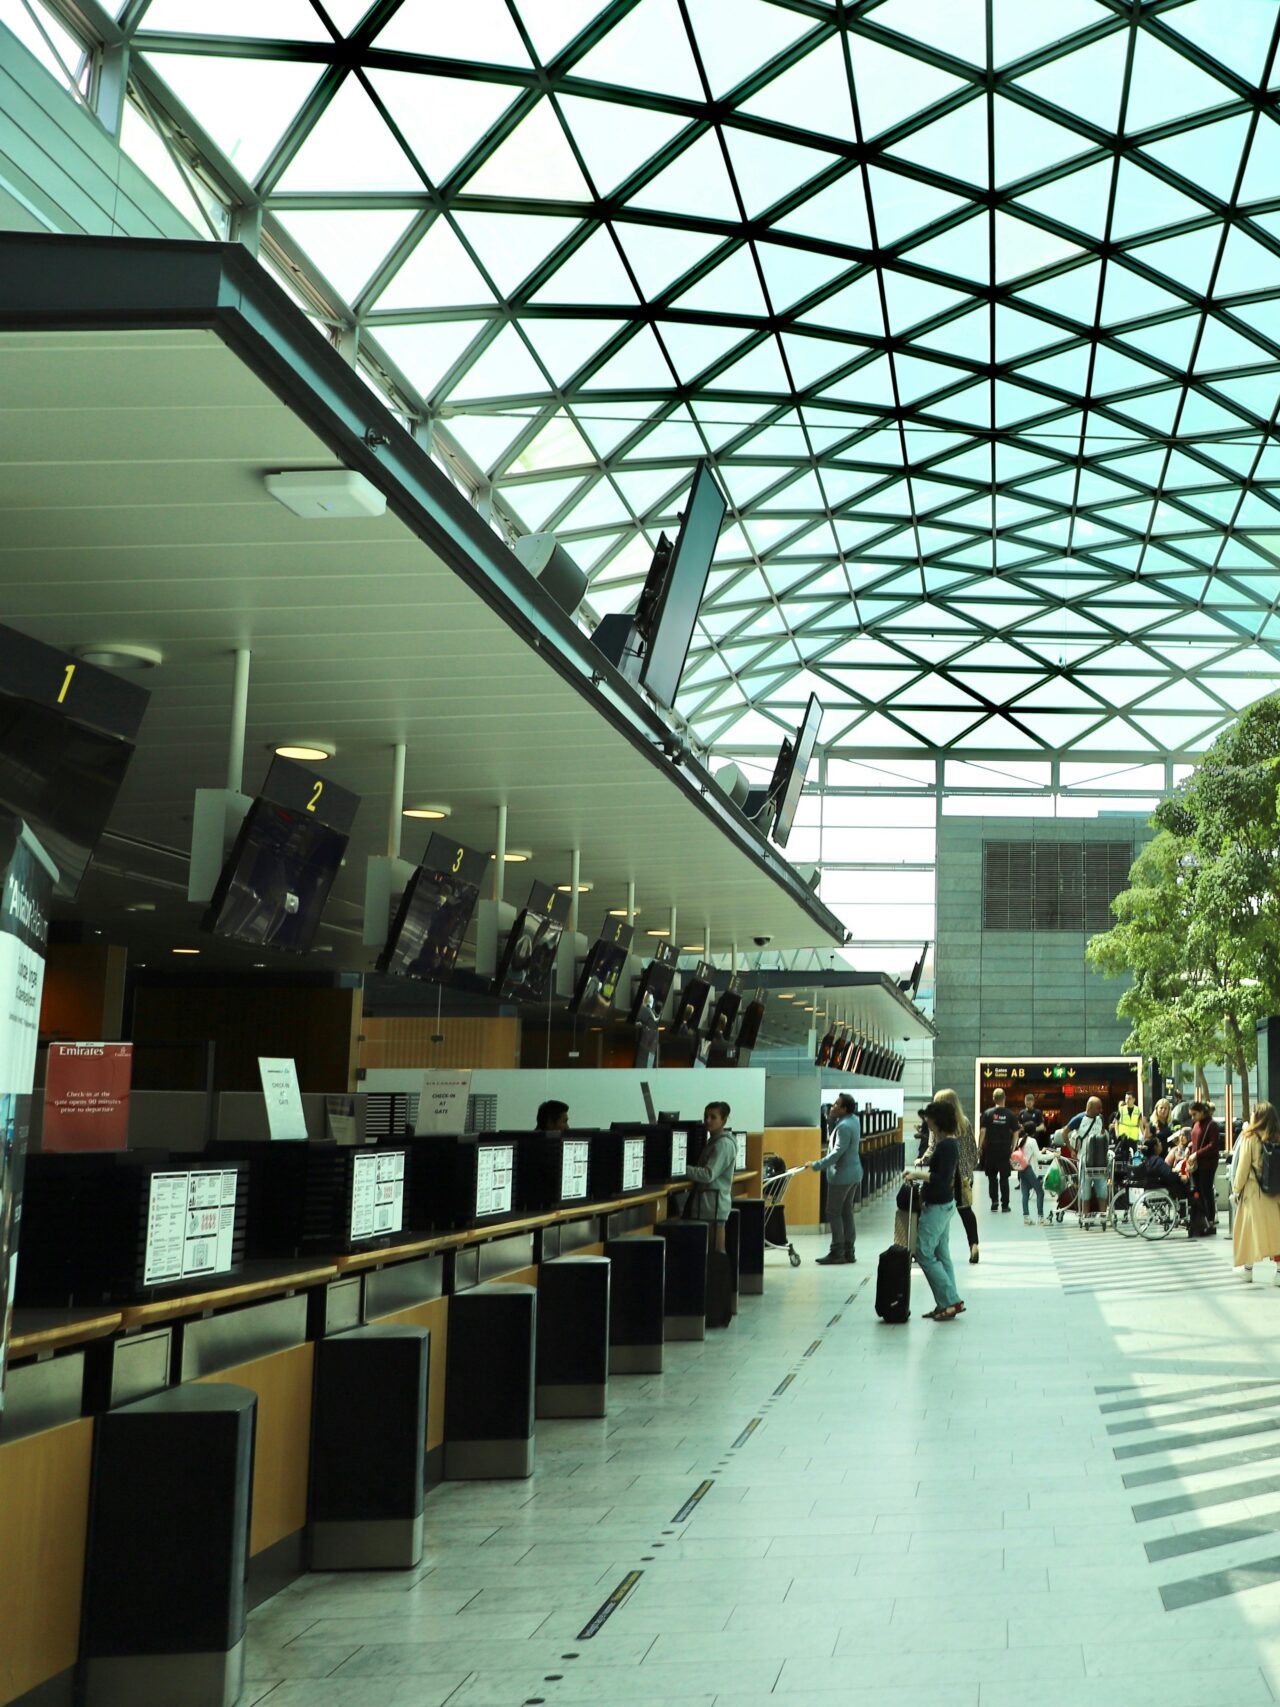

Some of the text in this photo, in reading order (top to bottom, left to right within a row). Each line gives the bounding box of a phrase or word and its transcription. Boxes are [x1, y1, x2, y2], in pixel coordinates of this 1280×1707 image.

[57, 664, 76, 703] 1
[306, 781, 323, 812] 2
[452, 848, 464, 872] 3
[546, 892, 556, 913] 4
[59, 1046, 104, 1056] Emirates
[1011, 1068, 1018, 1077] A
[1018, 1068, 1025, 1077] B
[85, 1106, 114, 1114] departure
